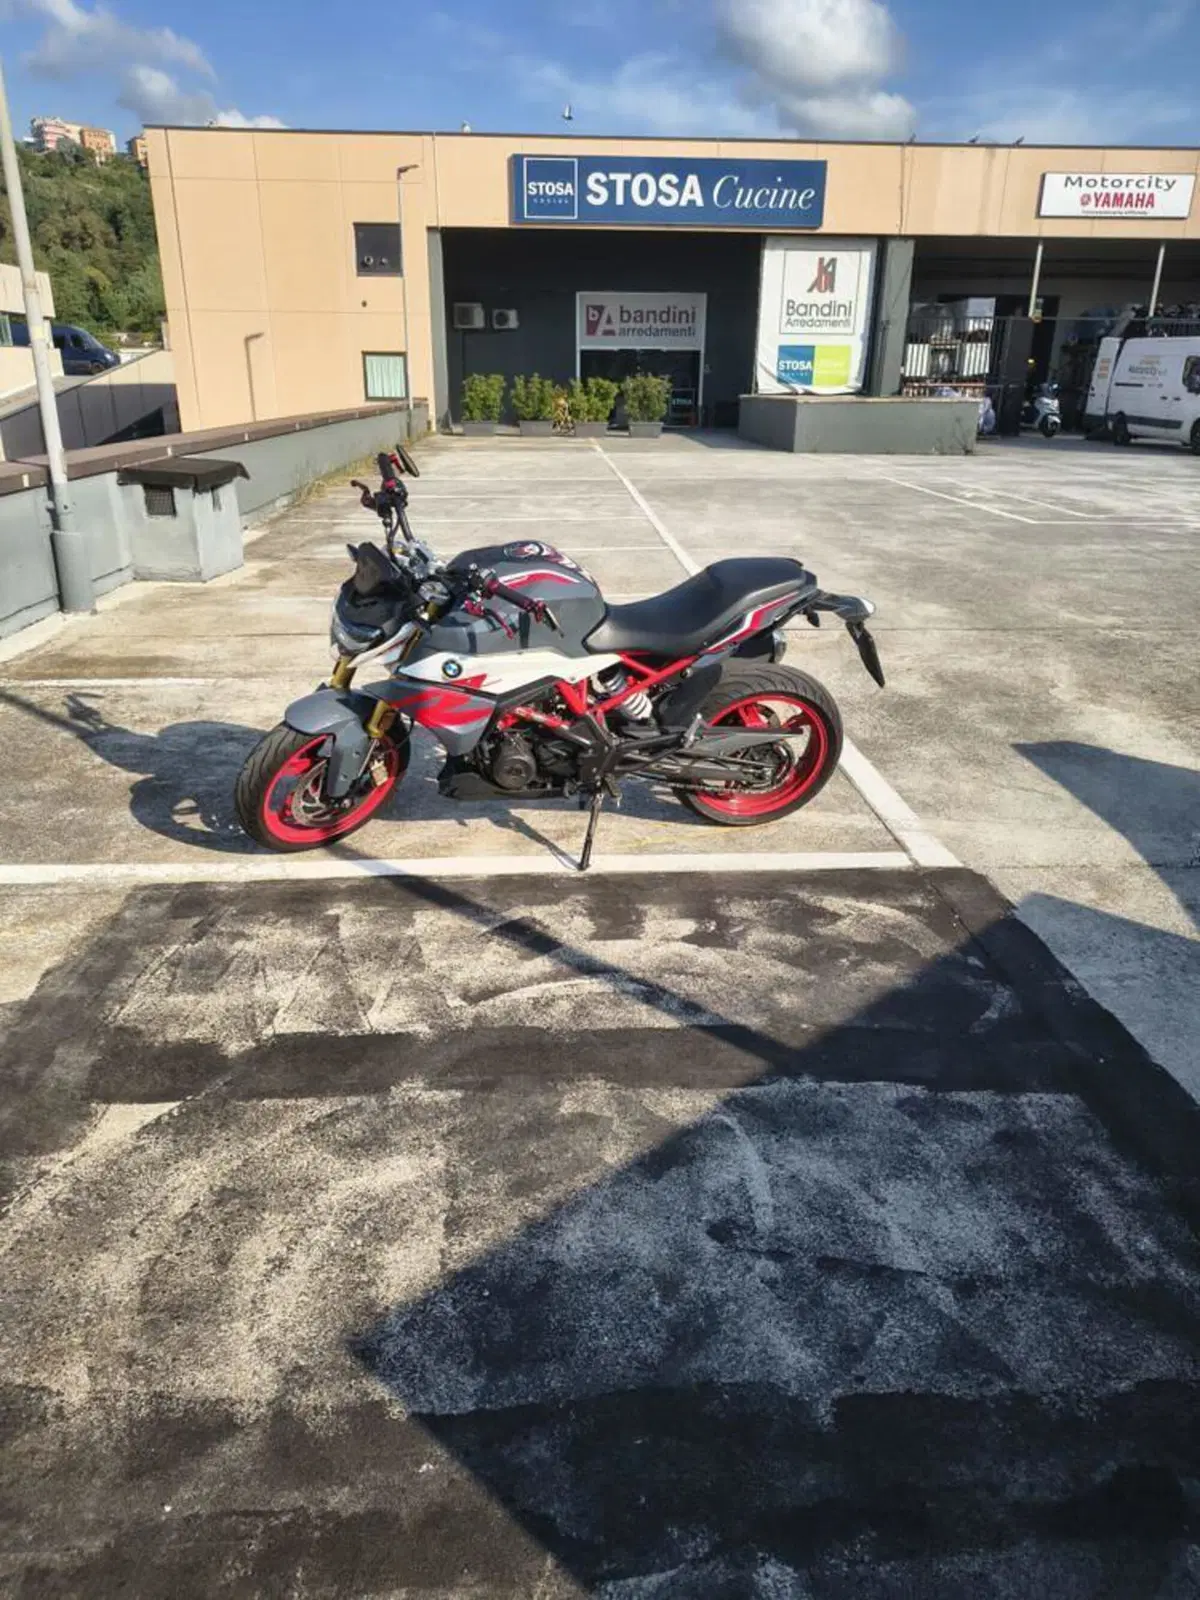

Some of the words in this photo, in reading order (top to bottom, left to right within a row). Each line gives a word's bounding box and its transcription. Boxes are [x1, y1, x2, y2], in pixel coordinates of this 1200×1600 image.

[528, 181, 574, 196] STOSA
[586, 172, 704, 207] STOSA
[712, 175, 815, 210] Cucine
[1064, 175, 1177, 191] Motorcity
[1093, 192, 1155, 208] YAMAHA
[619, 305, 696, 324] bandini
[786, 299, 853, 317] Bandini
[778, 360, 812, 371] STOSA
